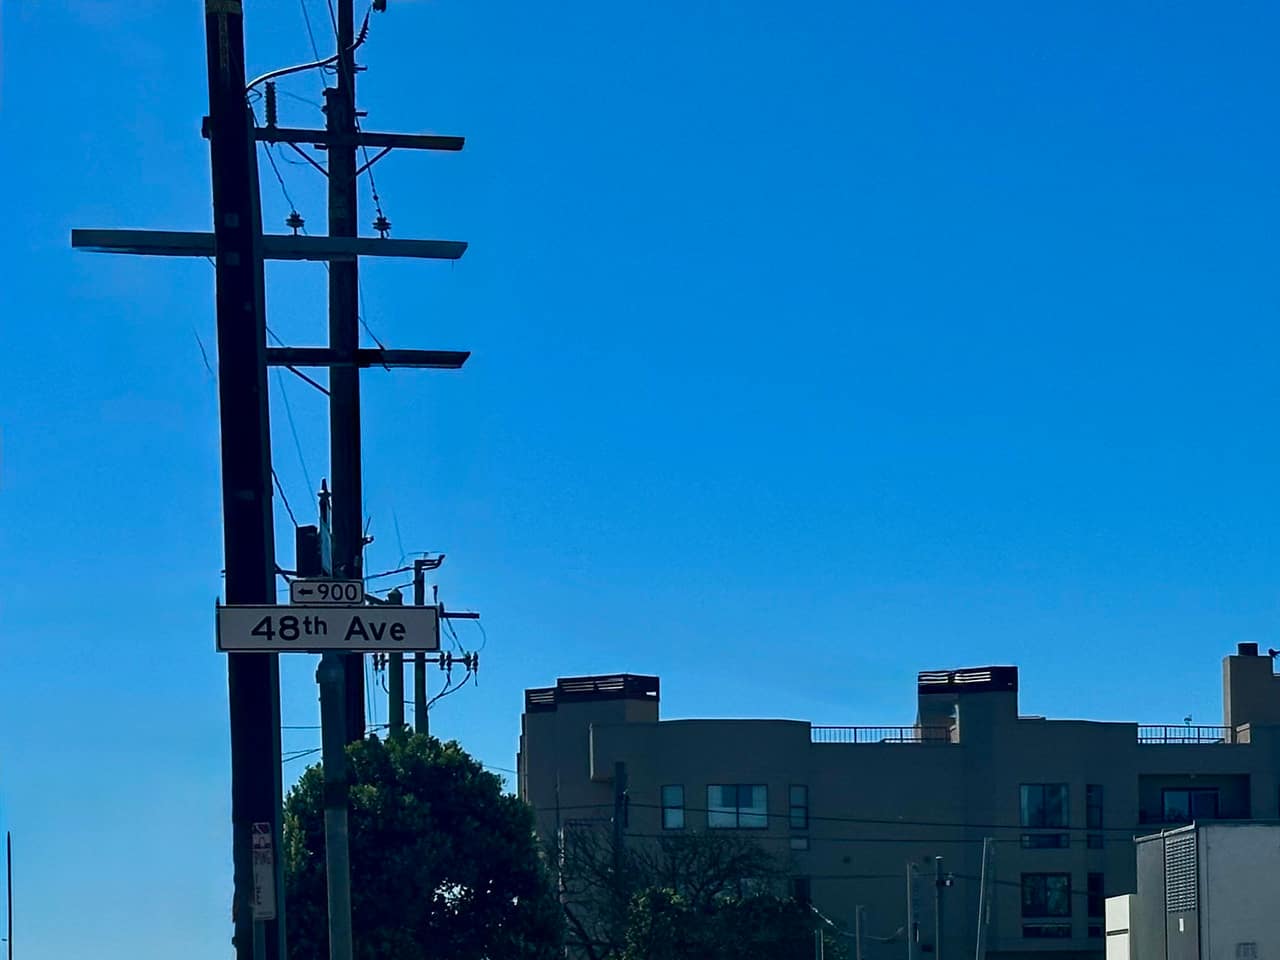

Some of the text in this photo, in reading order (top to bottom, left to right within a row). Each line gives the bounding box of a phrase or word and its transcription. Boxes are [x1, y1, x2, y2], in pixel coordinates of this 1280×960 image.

[317, 583, 358, 601] 900
[251, 616, 407, 642] 48th Ave
